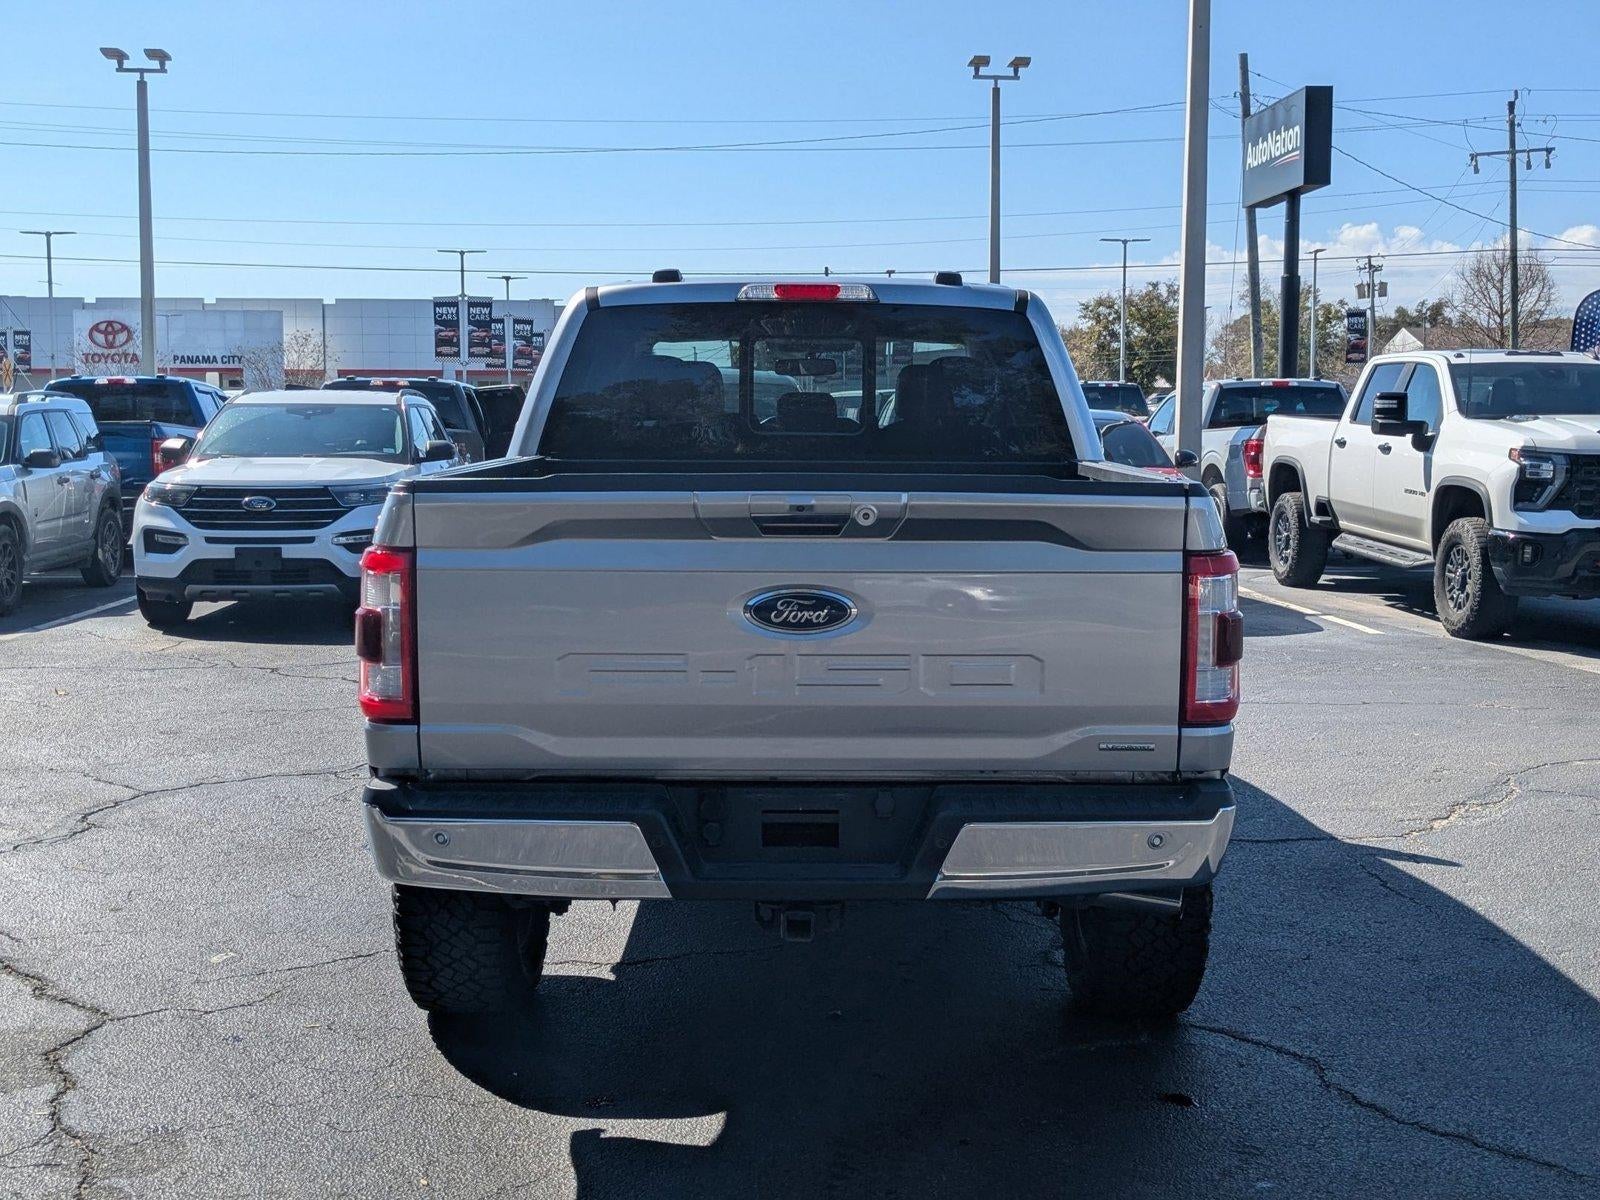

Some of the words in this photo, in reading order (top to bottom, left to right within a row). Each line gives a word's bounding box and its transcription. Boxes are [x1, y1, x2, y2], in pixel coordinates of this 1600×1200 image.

[1246, 125, 1300, 171] AutoNation
[436, 306, 457, 314] NEW
[469, 306, 490, 314] NEW
[82, 353, 140, 364] TOYOTA
[173, 355, 219, 365] PANAMA
[221, 355, 243, 365] CITY
[770, 598, 830, 624] Ford
[556, 653, 1046, 698] F-150
